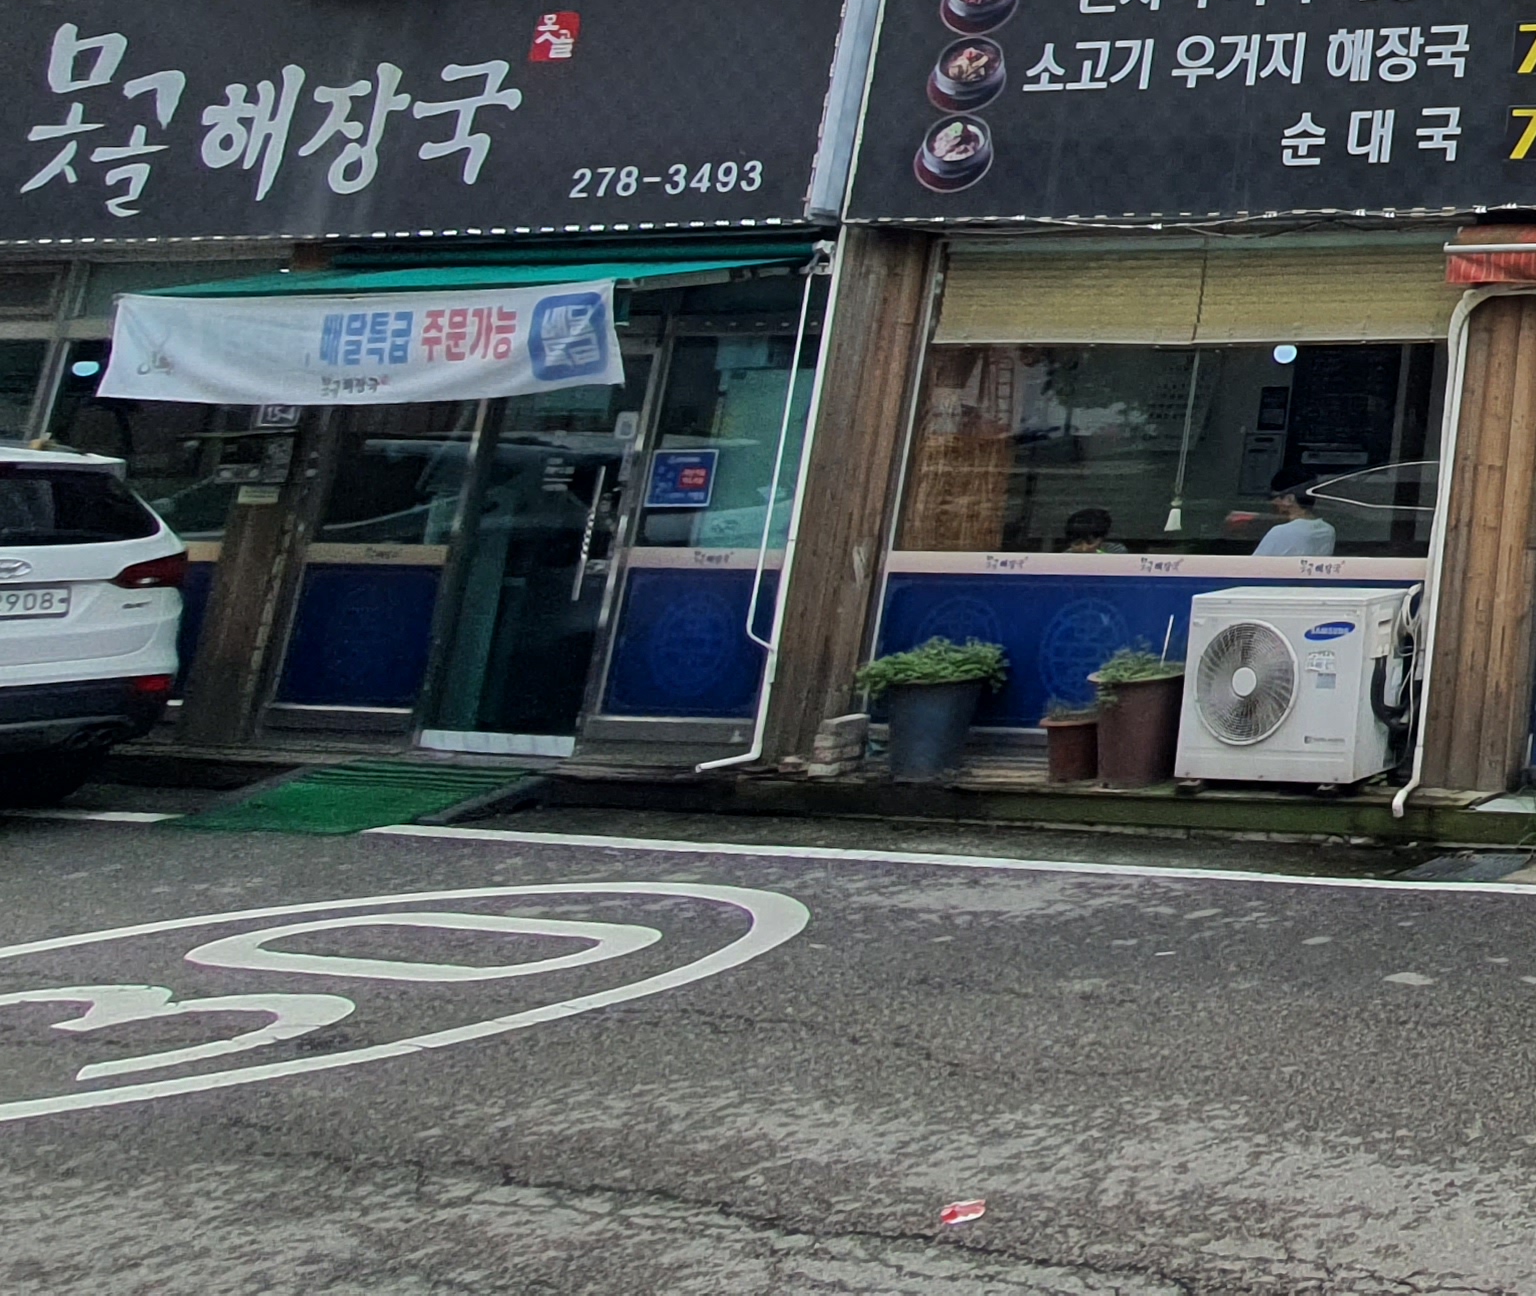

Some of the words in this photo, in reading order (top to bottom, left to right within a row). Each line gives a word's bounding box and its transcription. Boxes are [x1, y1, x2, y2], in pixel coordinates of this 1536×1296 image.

[1023, 38, 1152, 92] 소고기
[1170, 32, 1305, 87] 우거지
[1327, 24, 1469, 80] 해장국
[569, 159, 763, 200] 278-3493
[320, 312, 414, 365] 배달특급
[421, 307, 517, 361] 주문가능
[0, 592, 54, 611] 908
